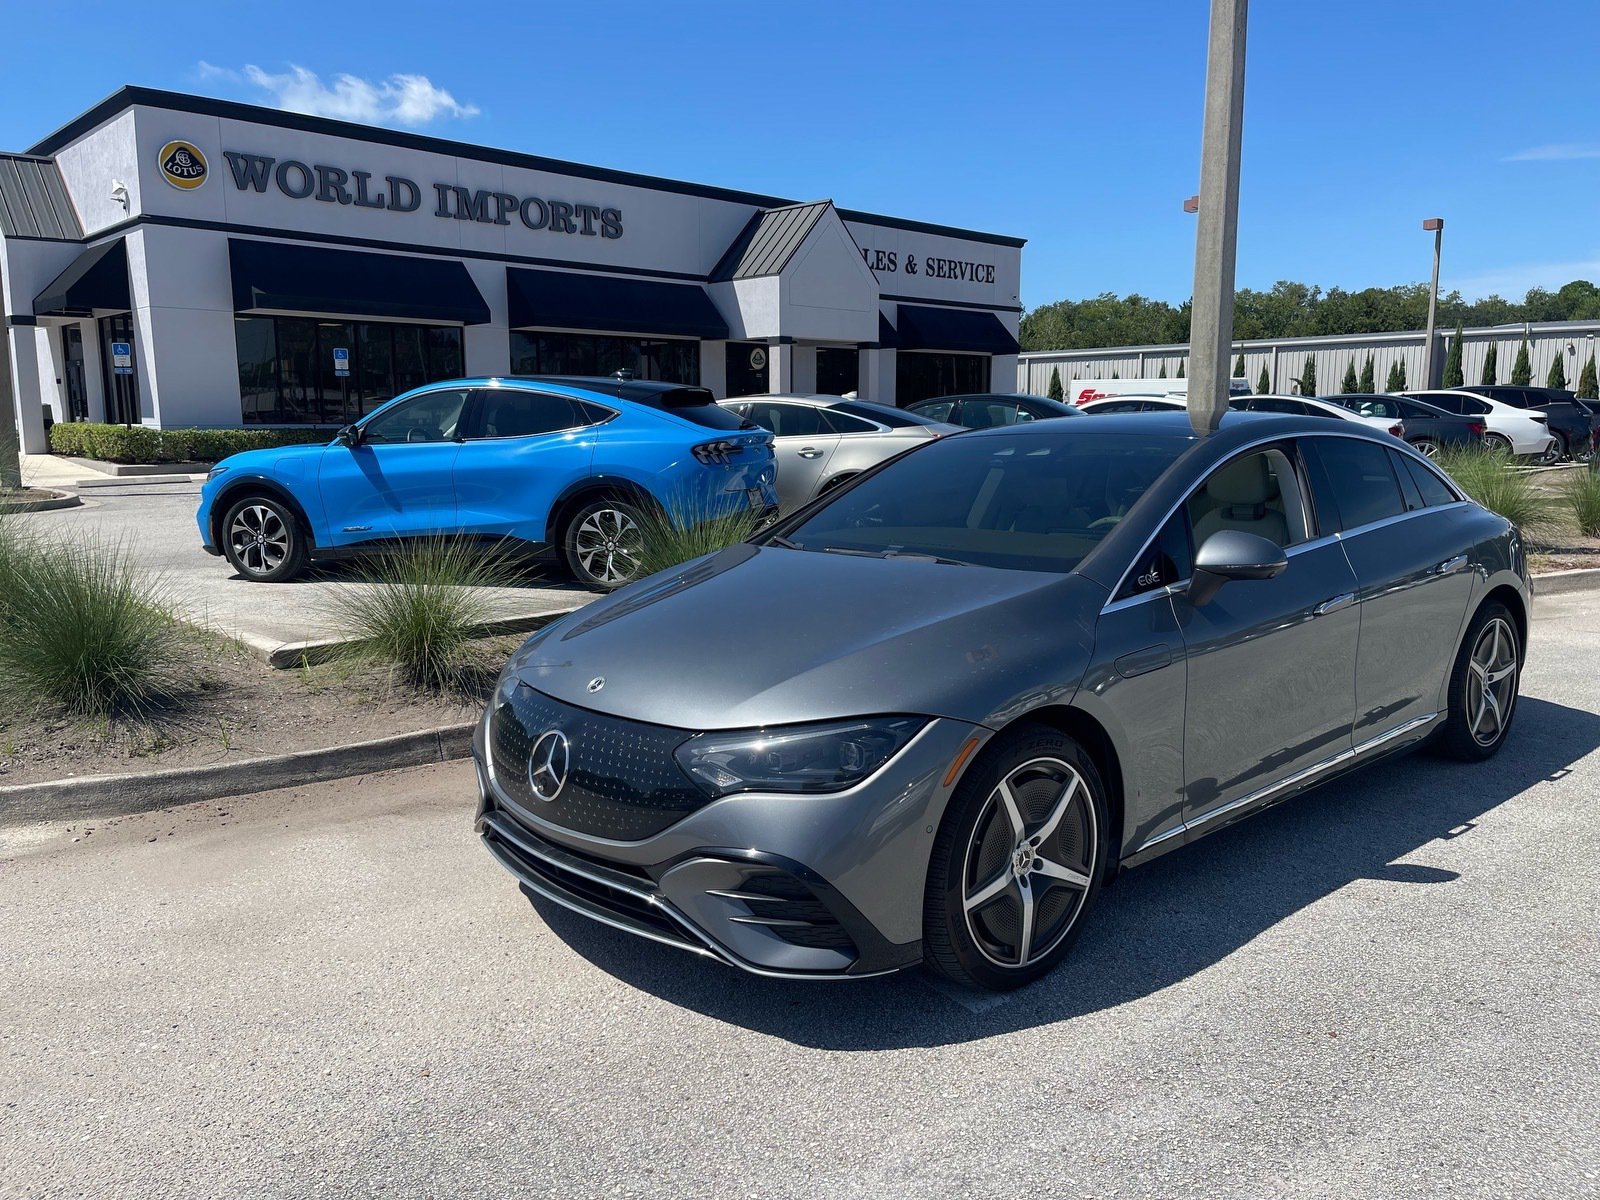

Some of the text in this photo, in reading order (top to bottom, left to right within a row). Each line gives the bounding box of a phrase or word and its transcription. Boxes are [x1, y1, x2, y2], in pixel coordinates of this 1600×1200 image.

[166, 161, 204, 176] LOTUS
[223, 151, 624, 239] WORLD IMPORTS
[905, 254, 918, 275] &
[925, 256, 995, 284] SERVICE
[1137, 571, 1160, 586] EQE
